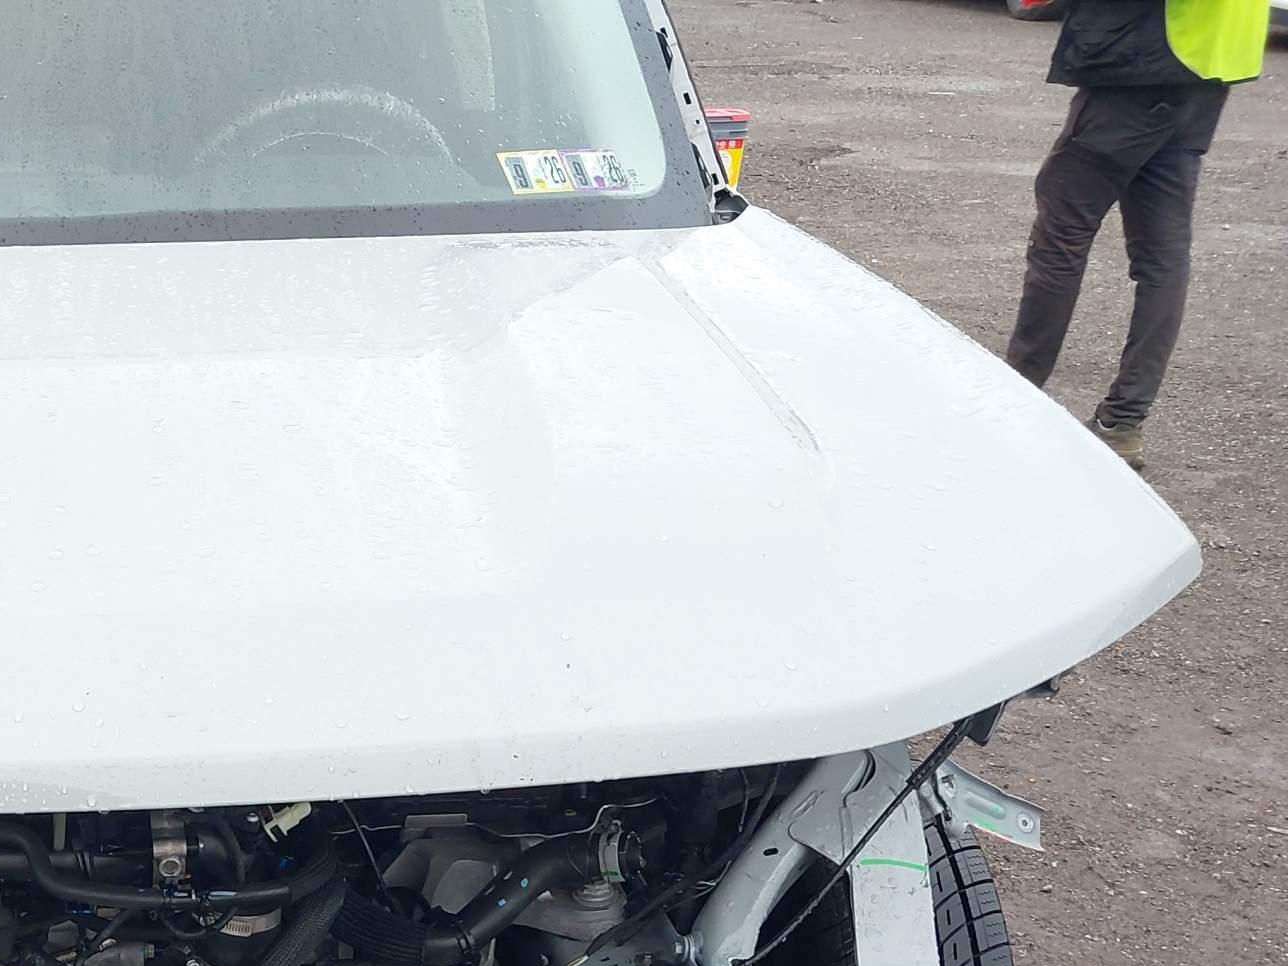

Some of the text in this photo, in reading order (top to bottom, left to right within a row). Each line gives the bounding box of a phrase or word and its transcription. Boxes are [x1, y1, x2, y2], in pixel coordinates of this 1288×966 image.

[513, 156, 566, 188] 9 26
[572, 161, 589, 186] 9
